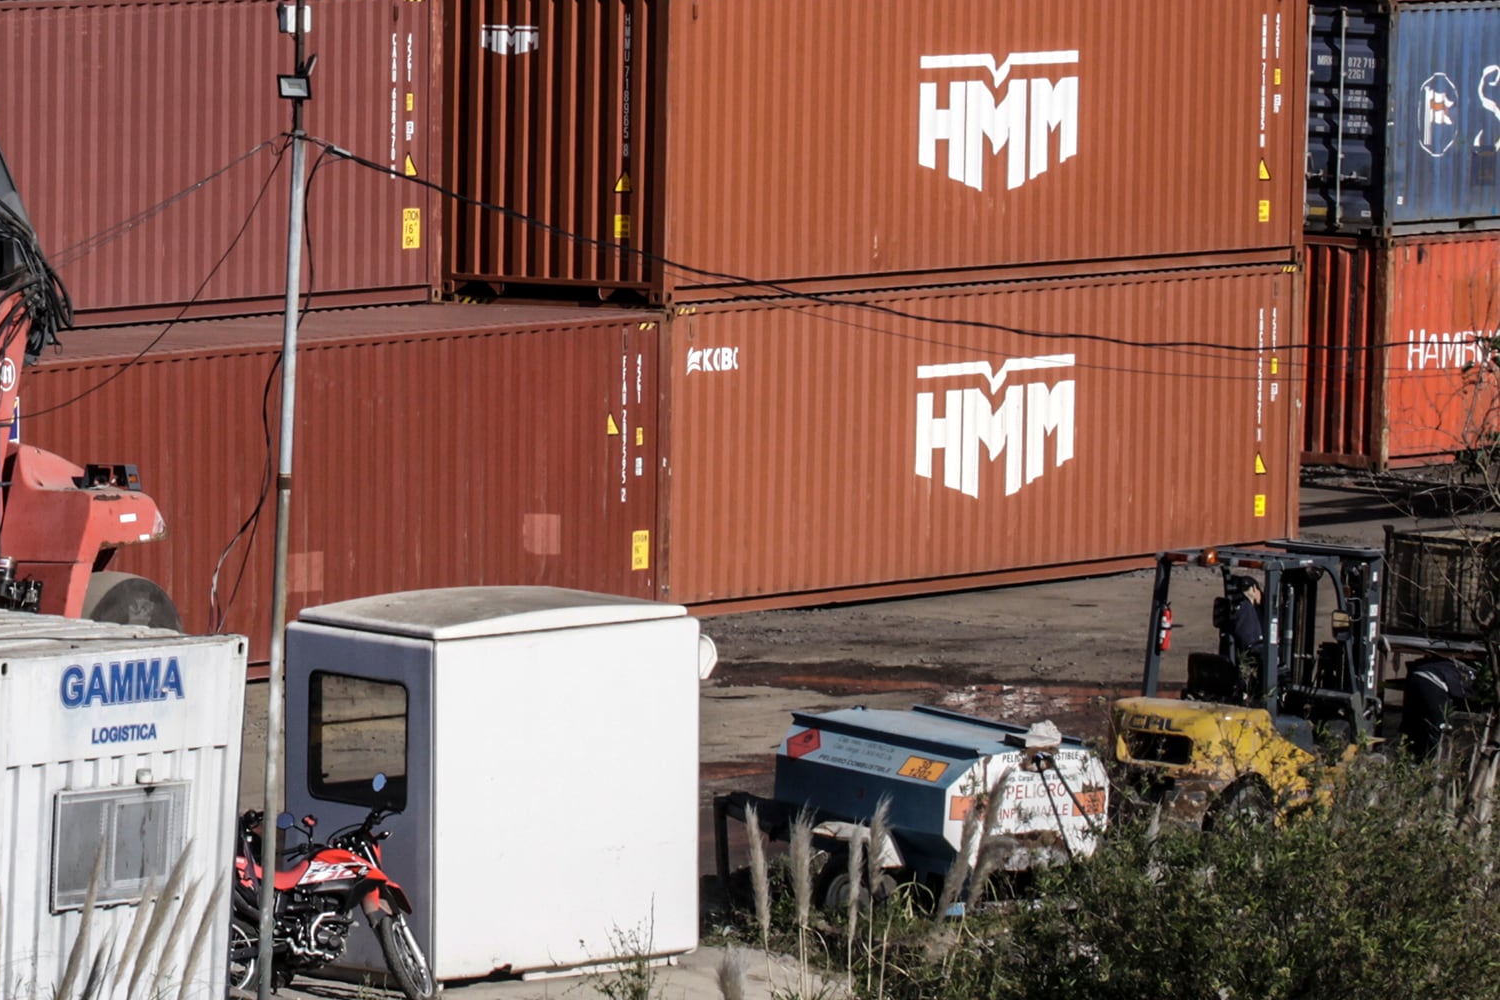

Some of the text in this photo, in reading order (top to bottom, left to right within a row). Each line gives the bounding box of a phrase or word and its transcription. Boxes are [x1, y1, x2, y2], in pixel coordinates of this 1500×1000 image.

[482, 24, 539, 55] HMM
[919, 50, 1079, 191] HMM
[915, 354, 1075, 499] HMM
[59, 656, 185, 709] GAMMA
[91, 723, 157, 744] LOGISTICA
[909, 768, 932, 780] 1202
[1006, 783, 1067, 800] PELIGRO
